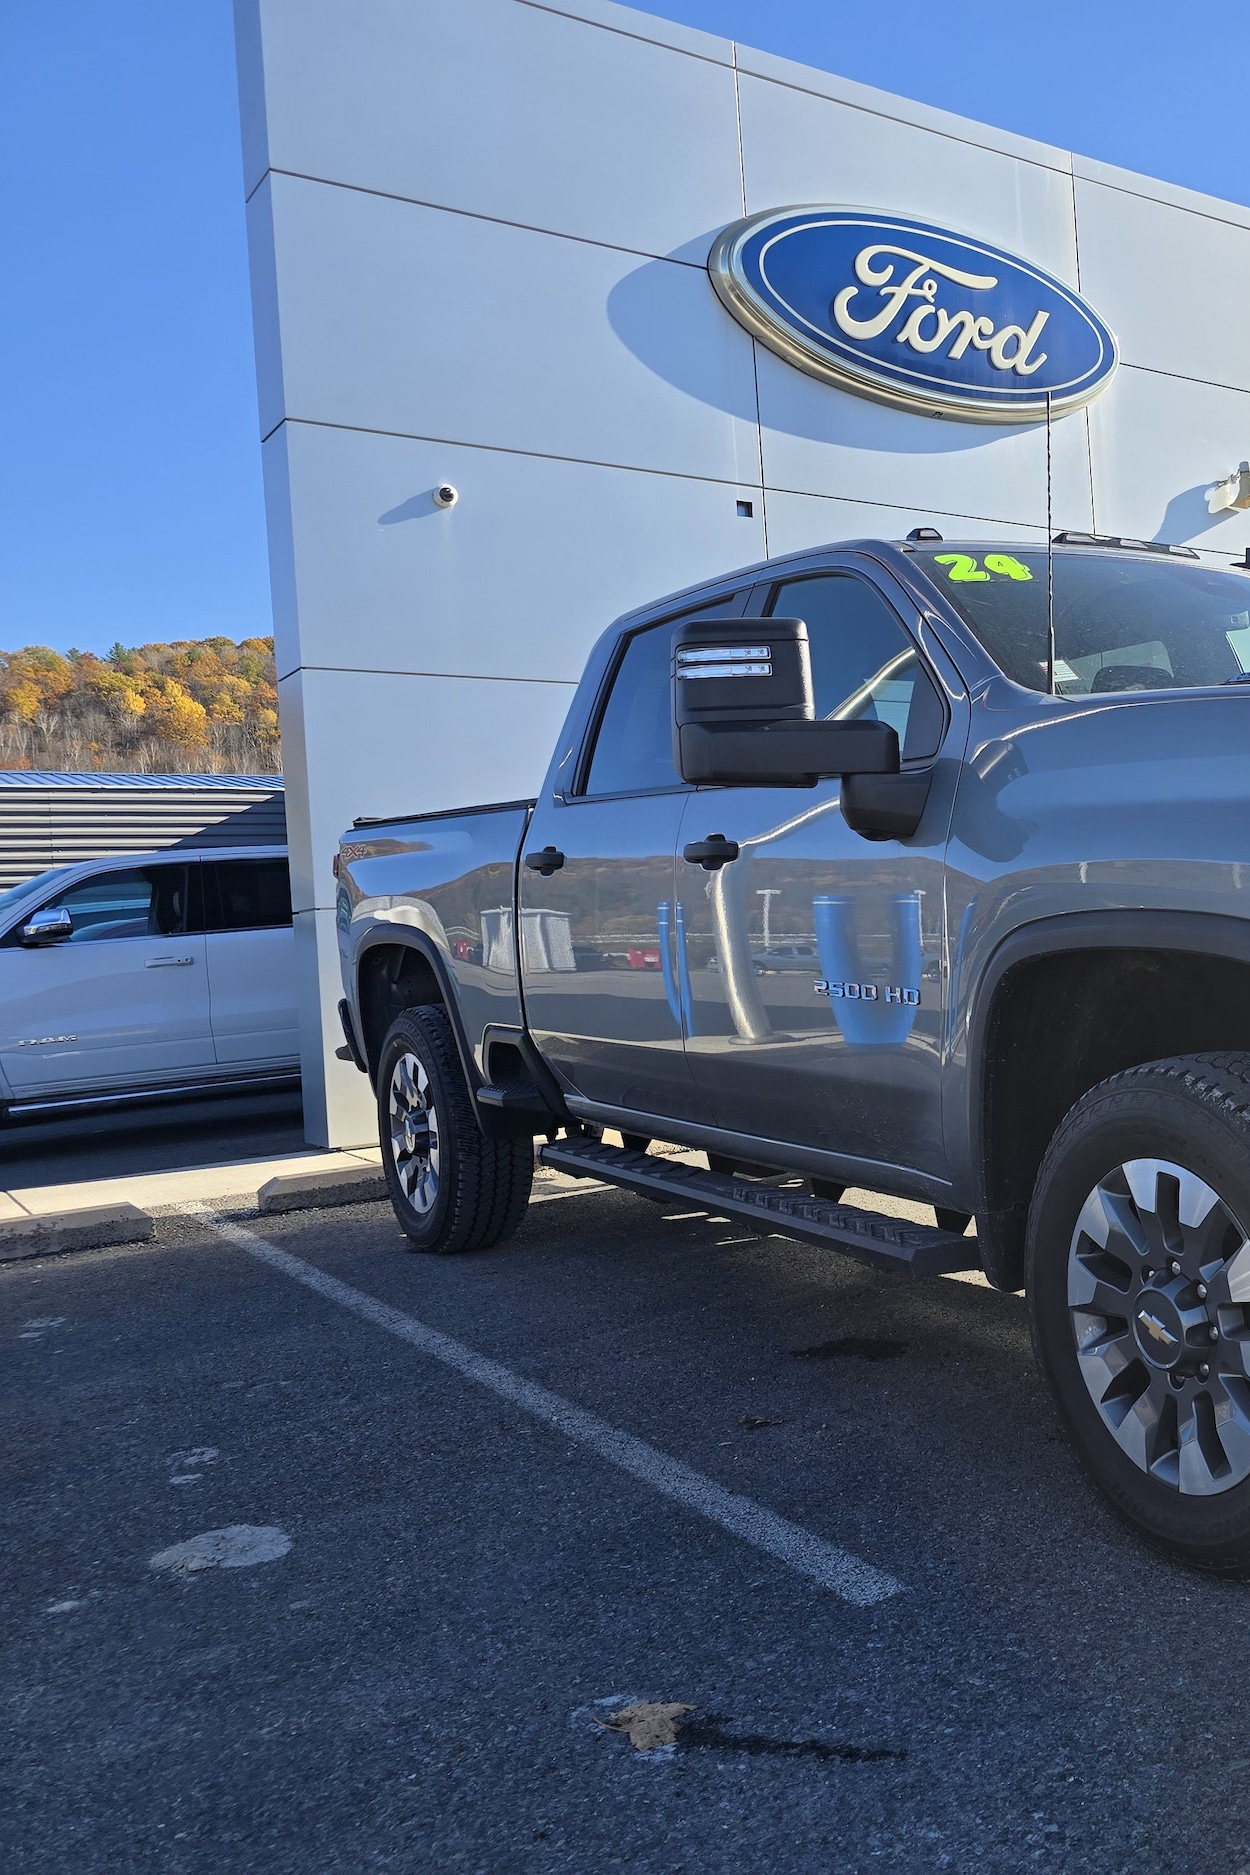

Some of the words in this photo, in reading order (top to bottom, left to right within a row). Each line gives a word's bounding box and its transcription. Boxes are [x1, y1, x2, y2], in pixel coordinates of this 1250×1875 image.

[833, 244, 1050, 376] Ford
[933, 553, 1034, 582] 24
[813, 980, 878, 1001] 2500
[885, 985, 920, 1006] HD
[18, 1034, 78, 1046] RAM
